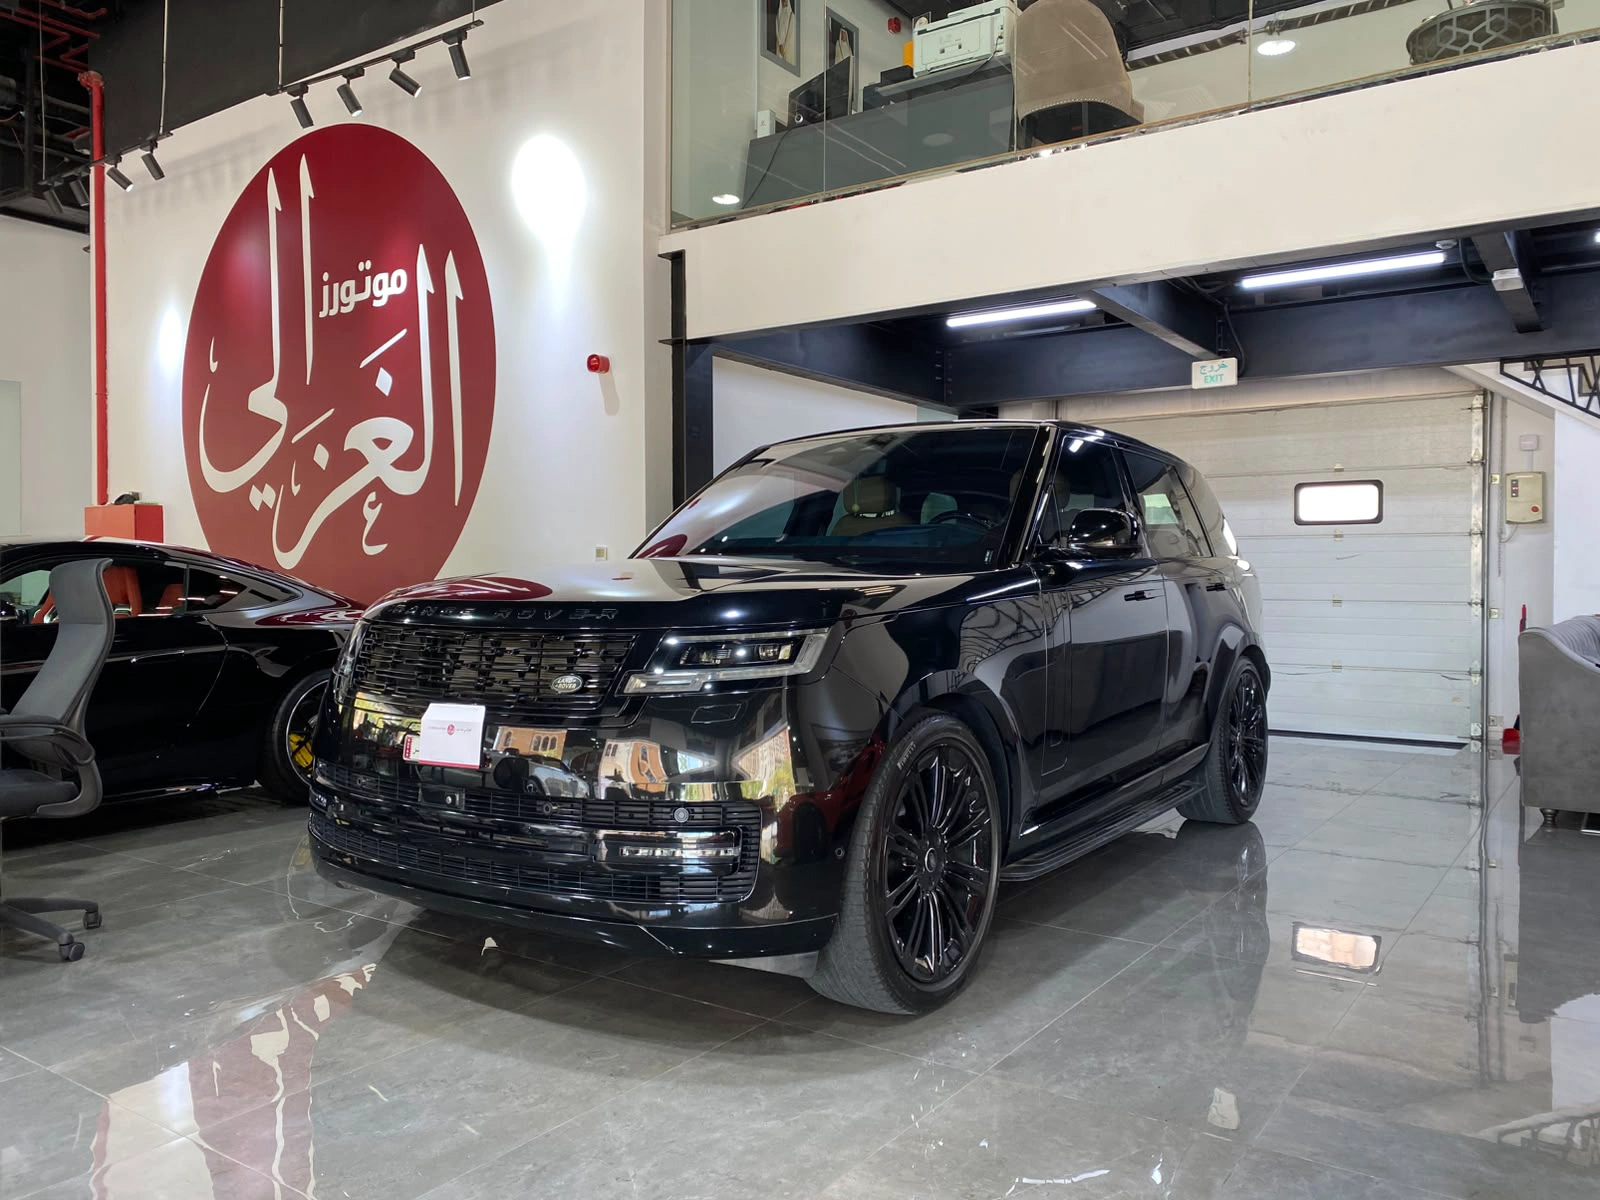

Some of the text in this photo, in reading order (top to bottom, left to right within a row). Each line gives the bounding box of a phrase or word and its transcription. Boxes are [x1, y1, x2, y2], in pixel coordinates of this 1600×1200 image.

[319, 260, 409, 319] موتورز
[1200, 361, 1228, 375] خروج
[1204, 374, 1224, 384] EXIT
[494, 608, 619, 620] ROVER
